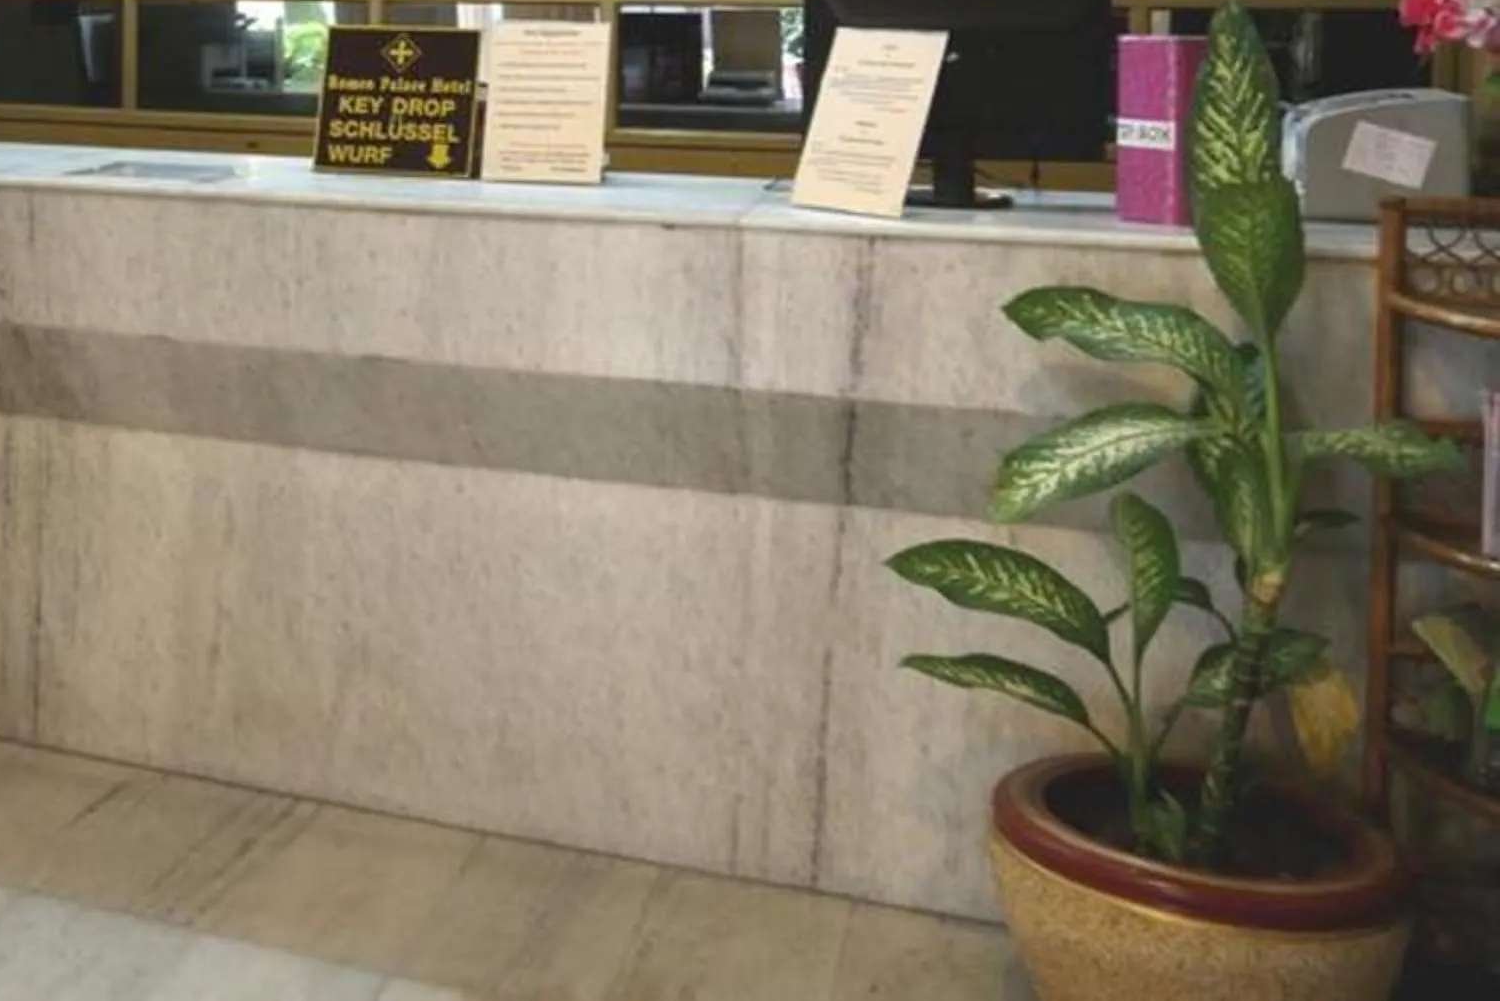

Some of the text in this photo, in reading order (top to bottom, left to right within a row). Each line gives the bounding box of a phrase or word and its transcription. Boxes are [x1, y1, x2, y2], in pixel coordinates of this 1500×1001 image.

[431, 76, 473, 95] Hotel
[338, 96, 456, 117] KEY DROP
[328, 116, 461, 144] SCHLÜSSEL
[327, 144, 393, 165] WURF
